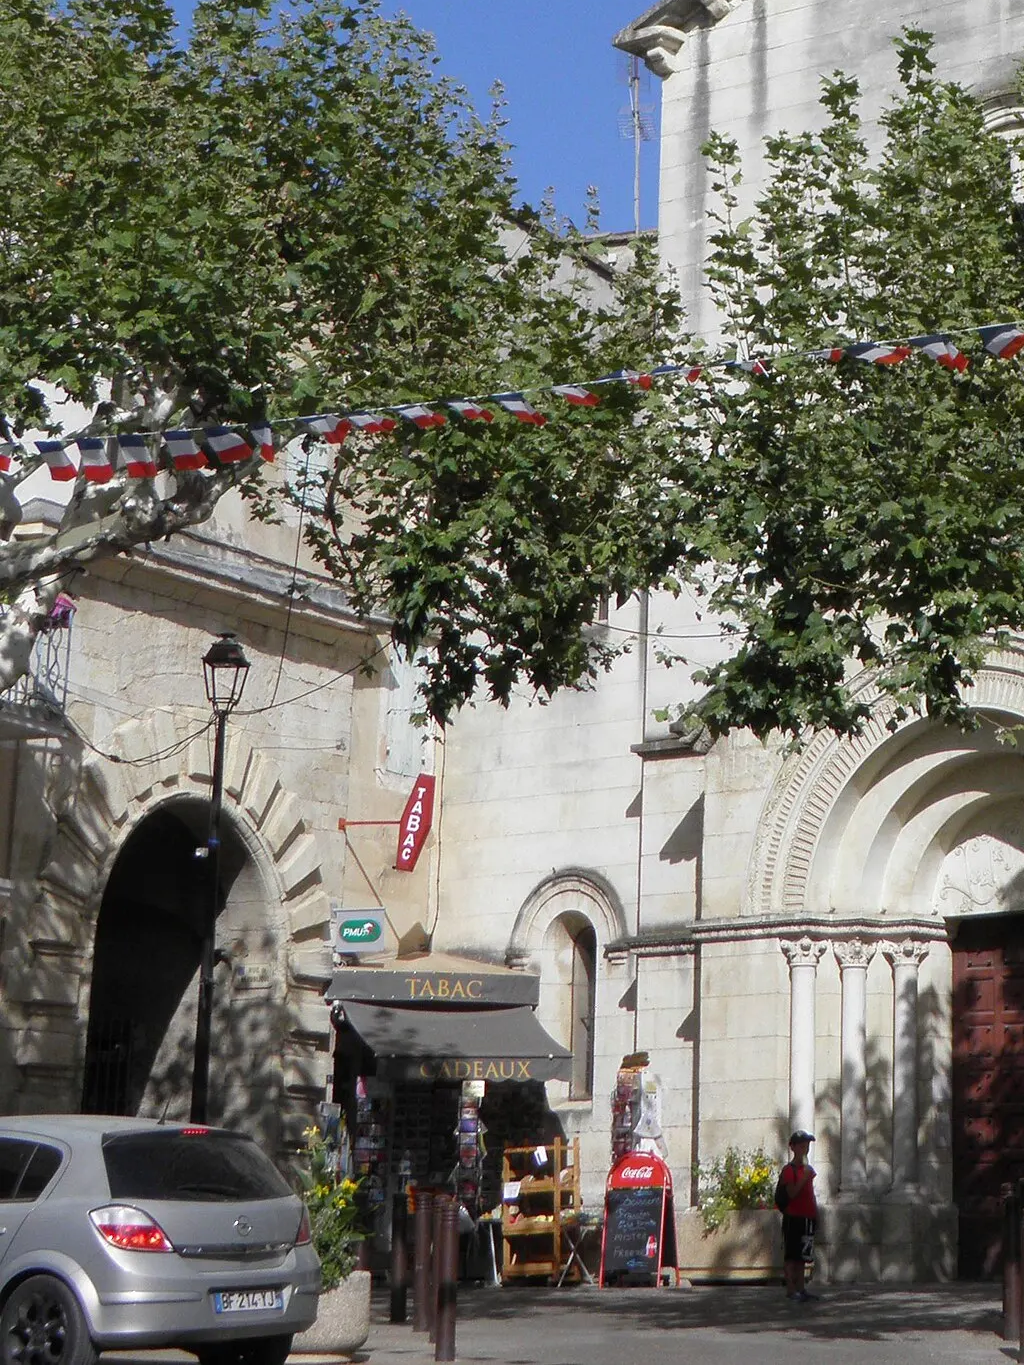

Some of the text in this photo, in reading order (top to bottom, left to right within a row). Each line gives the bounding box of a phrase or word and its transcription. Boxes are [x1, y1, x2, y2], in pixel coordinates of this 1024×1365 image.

[402, 787, 426, 861] TABAC
[343, 927, 363, 938] PMU
[404, 978, 483, 999] TABAC
[420, 1060, 532, 1080] CADEAUX
